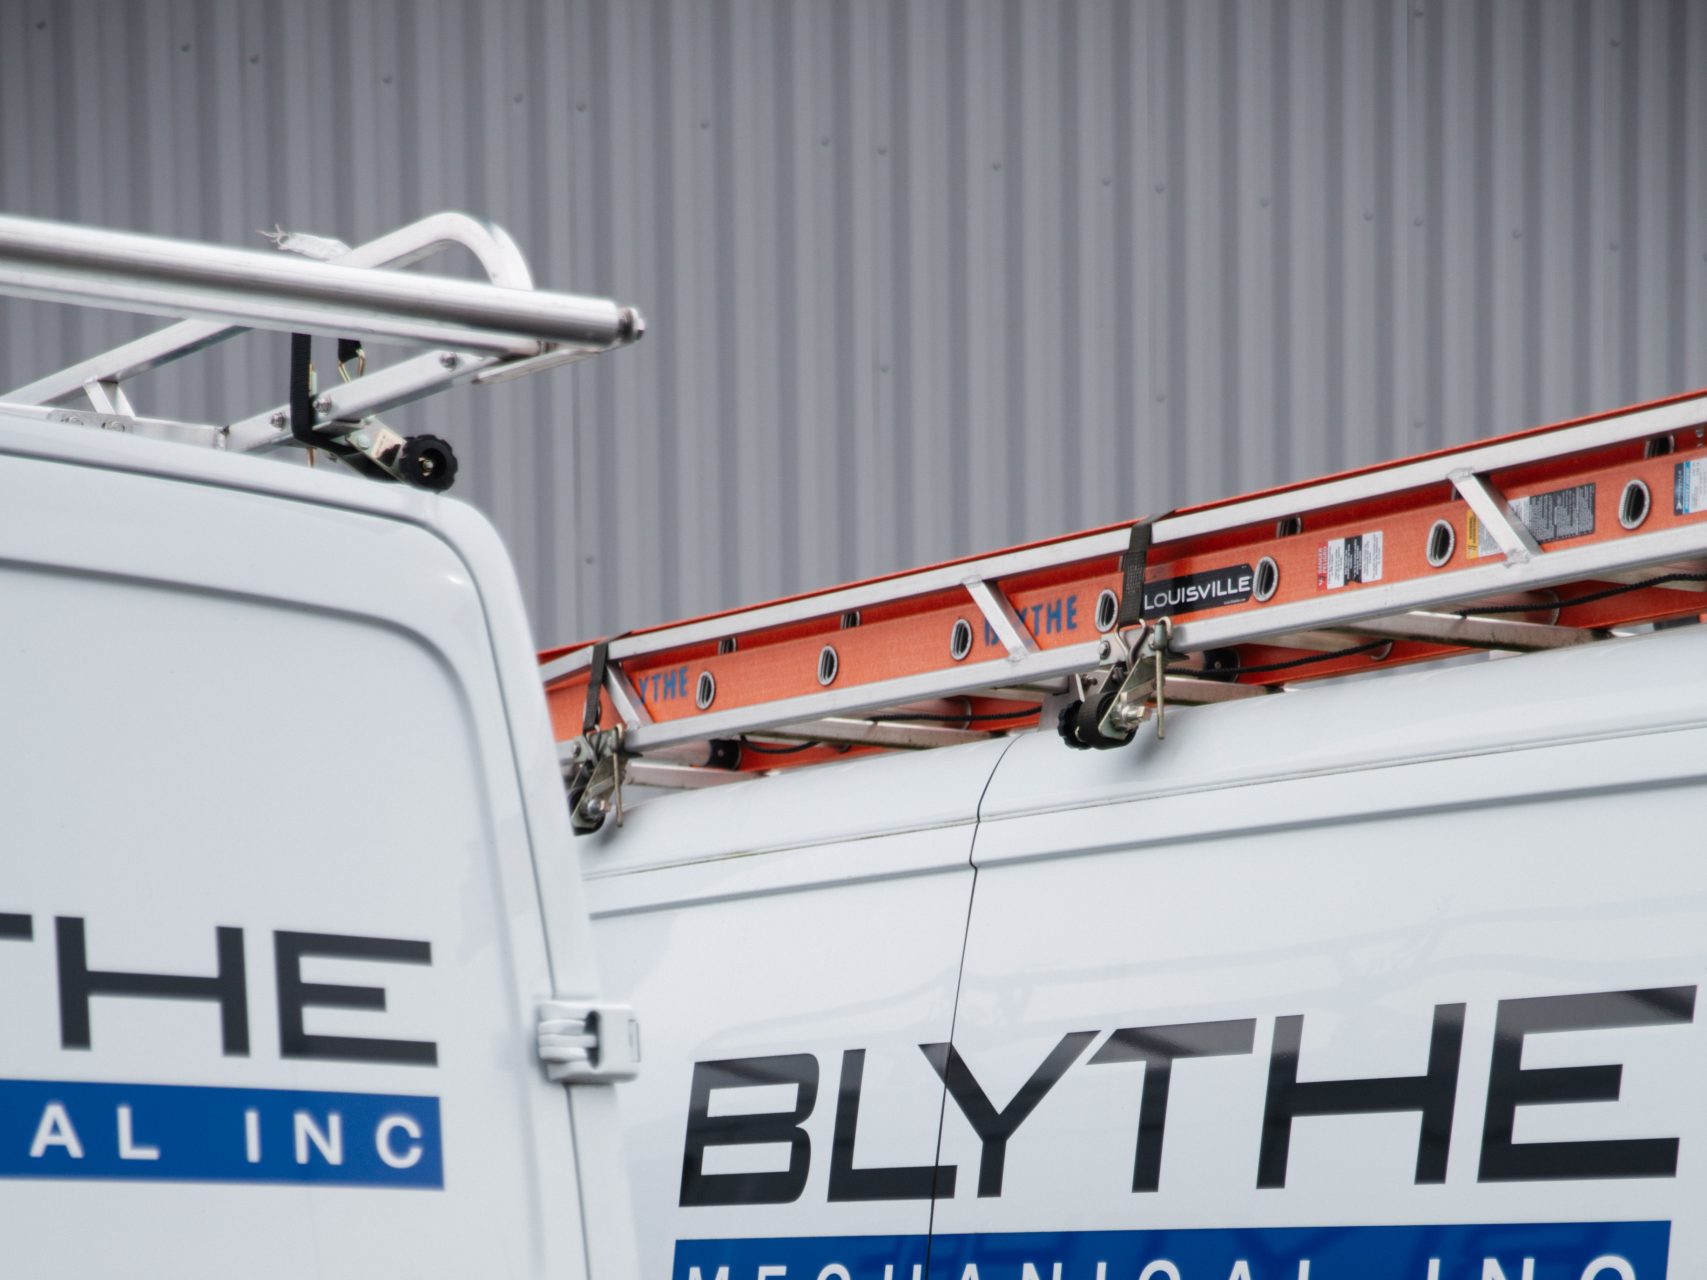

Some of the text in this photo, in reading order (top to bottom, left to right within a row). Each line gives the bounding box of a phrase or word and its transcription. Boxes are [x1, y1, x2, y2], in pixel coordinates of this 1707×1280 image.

[1144, 576, 1252, 610] LOUISVILLE
[0, 912, 439, 1067] HE
[244, 1108, 424, 1169] INC
[679, 985, 1698, 1207] BLYTHE
